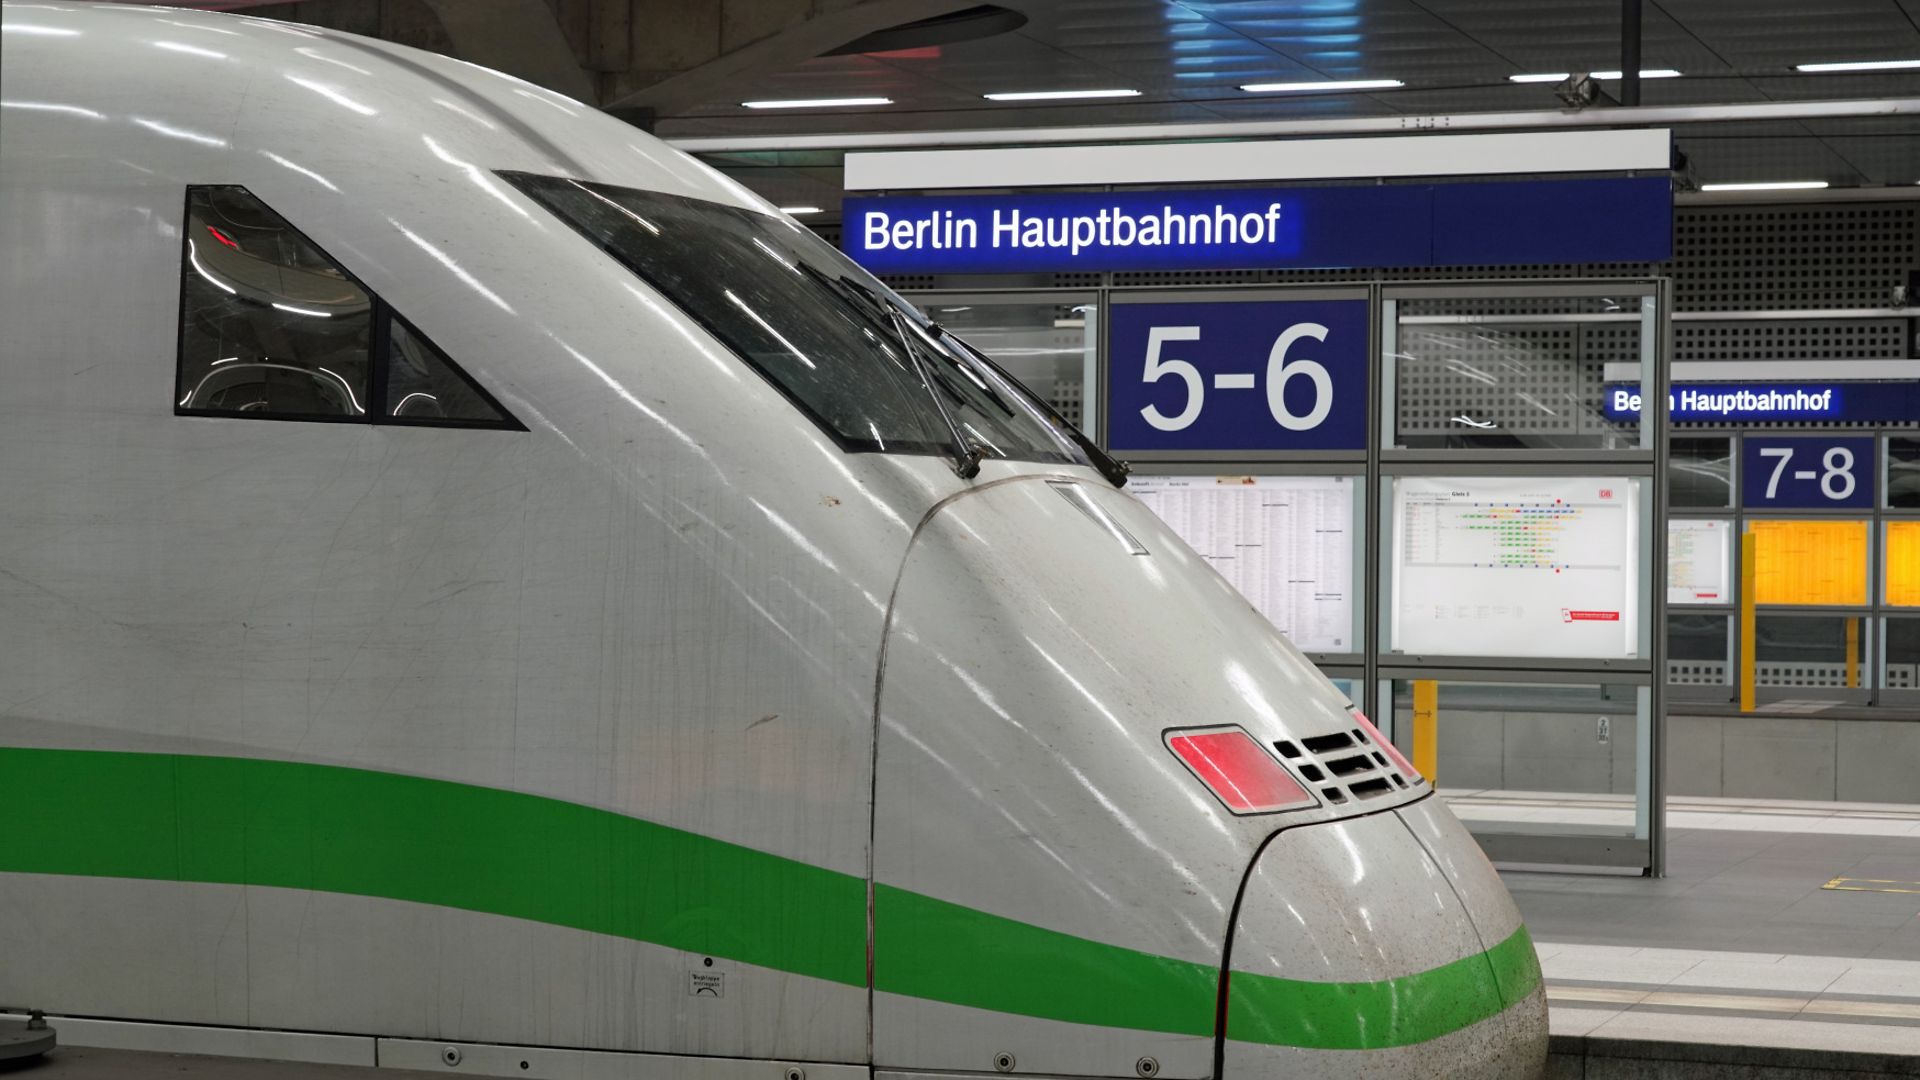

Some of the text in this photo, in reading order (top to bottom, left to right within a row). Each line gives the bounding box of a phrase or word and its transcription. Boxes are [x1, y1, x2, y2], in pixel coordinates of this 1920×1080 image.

[864, 202, 1281, 256] Berlin Hauptbahnhof
[1140, 322, 1333, 432] 5-6
[1681, 389, 1832, 415] Hauptbahnhof
[1760, 447, 1856, 500] 7-8
